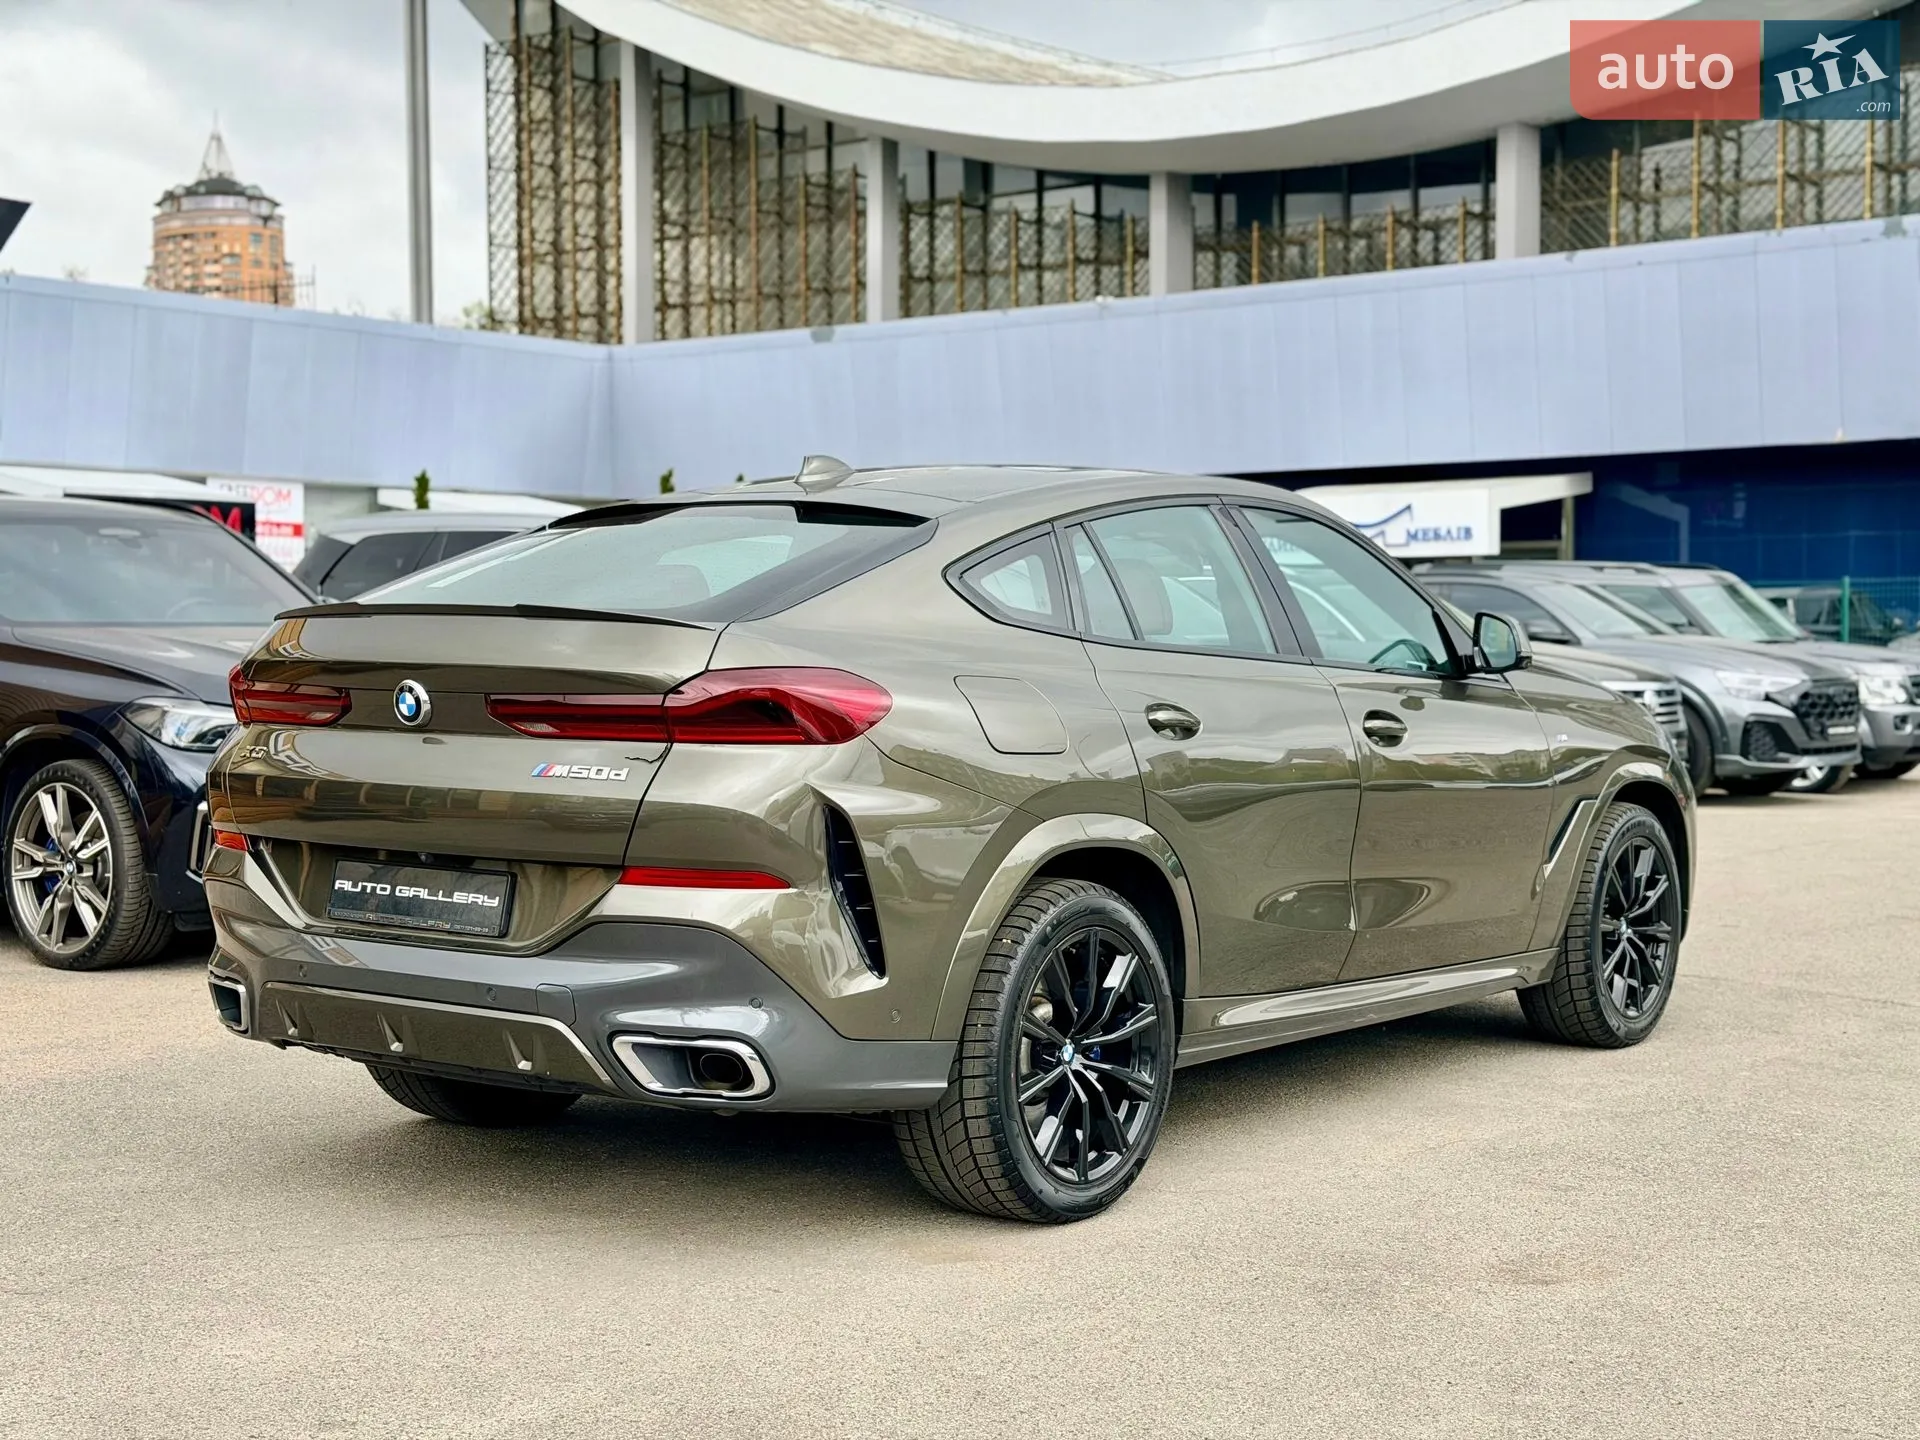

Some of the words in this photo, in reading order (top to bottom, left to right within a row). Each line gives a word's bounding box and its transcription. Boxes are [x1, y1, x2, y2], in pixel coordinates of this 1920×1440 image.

[546, 764, 630, 781] M50d
[334, 879, 391, 895] AUTO
[395, 886, 500, 907] GALLERY
